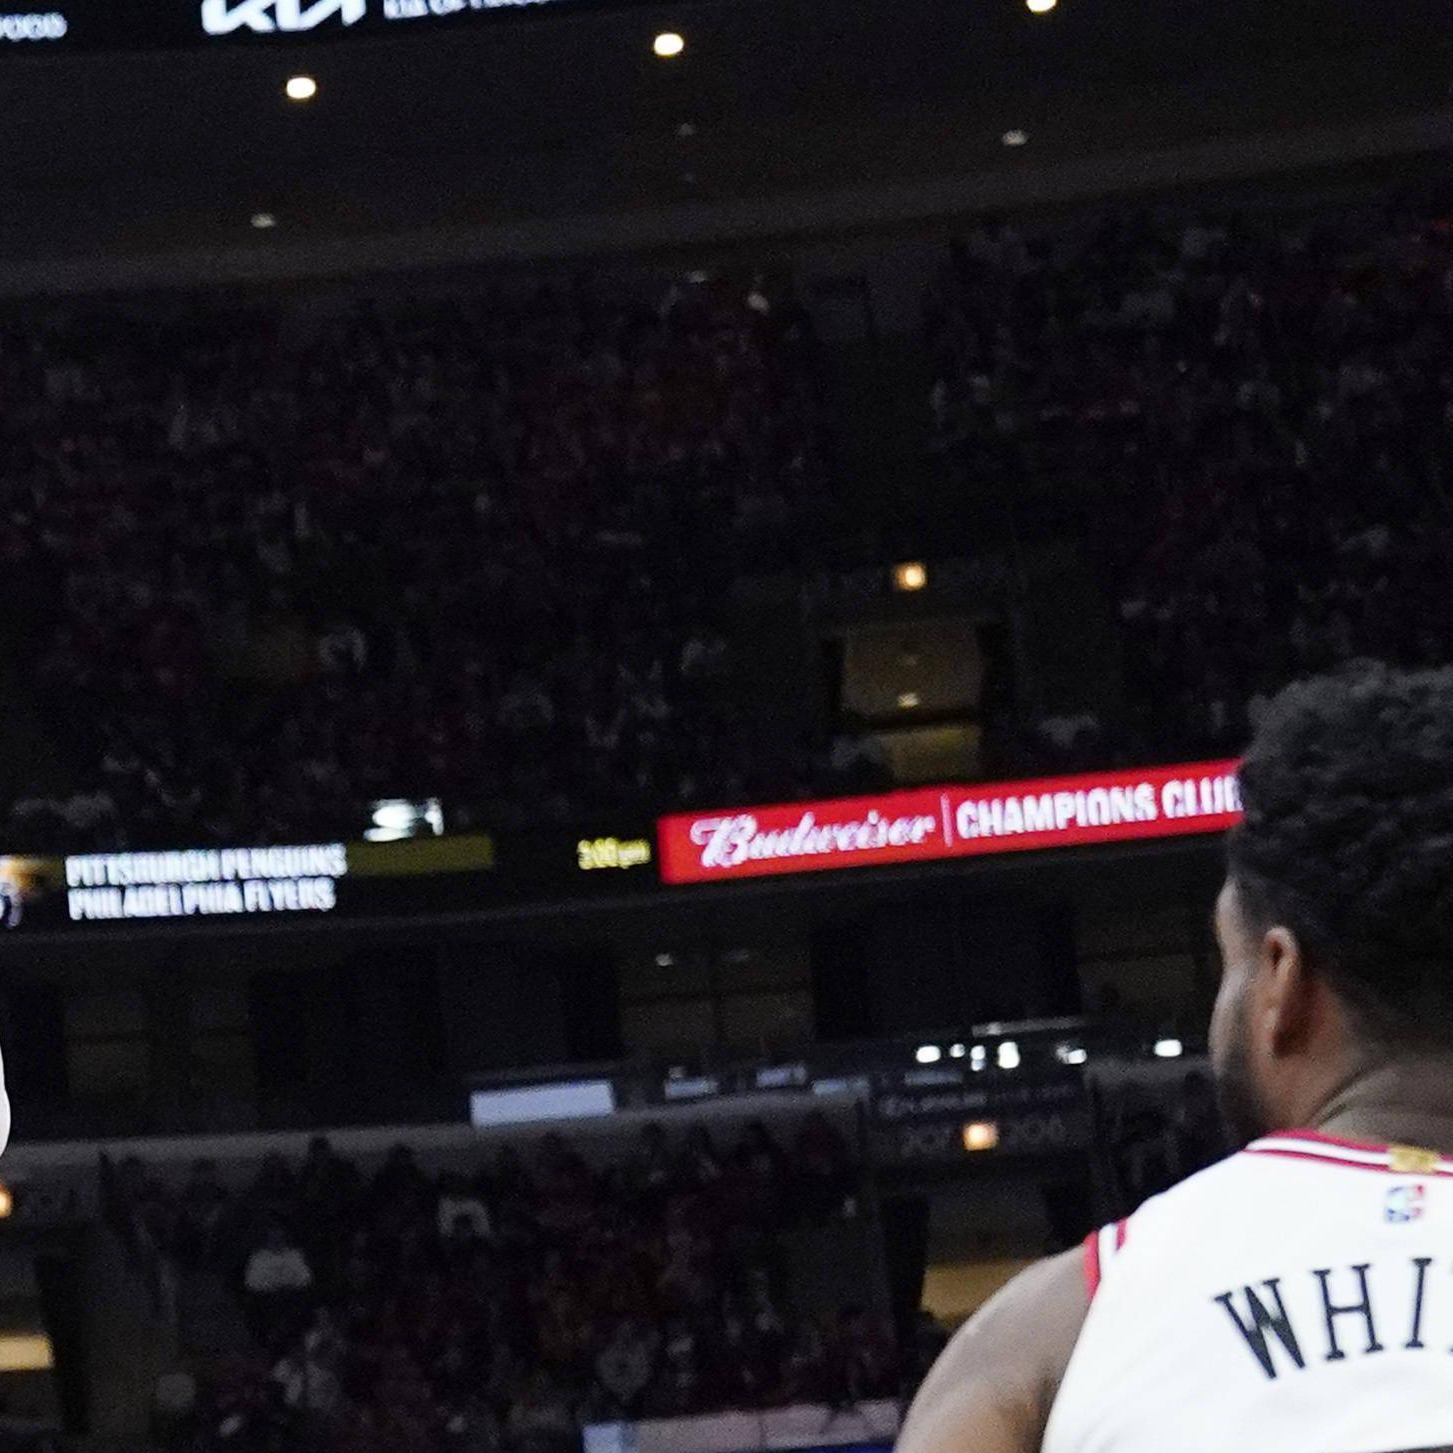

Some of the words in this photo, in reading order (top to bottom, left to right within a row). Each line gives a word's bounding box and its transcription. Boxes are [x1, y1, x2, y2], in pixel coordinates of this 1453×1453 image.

[65, 848, 221, 888] PITTSBURGH
[220, 842, 348, 881] PENGUINS
[691, 809, 936, 868] Budweiser
[955, 782, 1159, 840] CHAMPIONS
[1213, 1256, 1453, 1380] WHI
